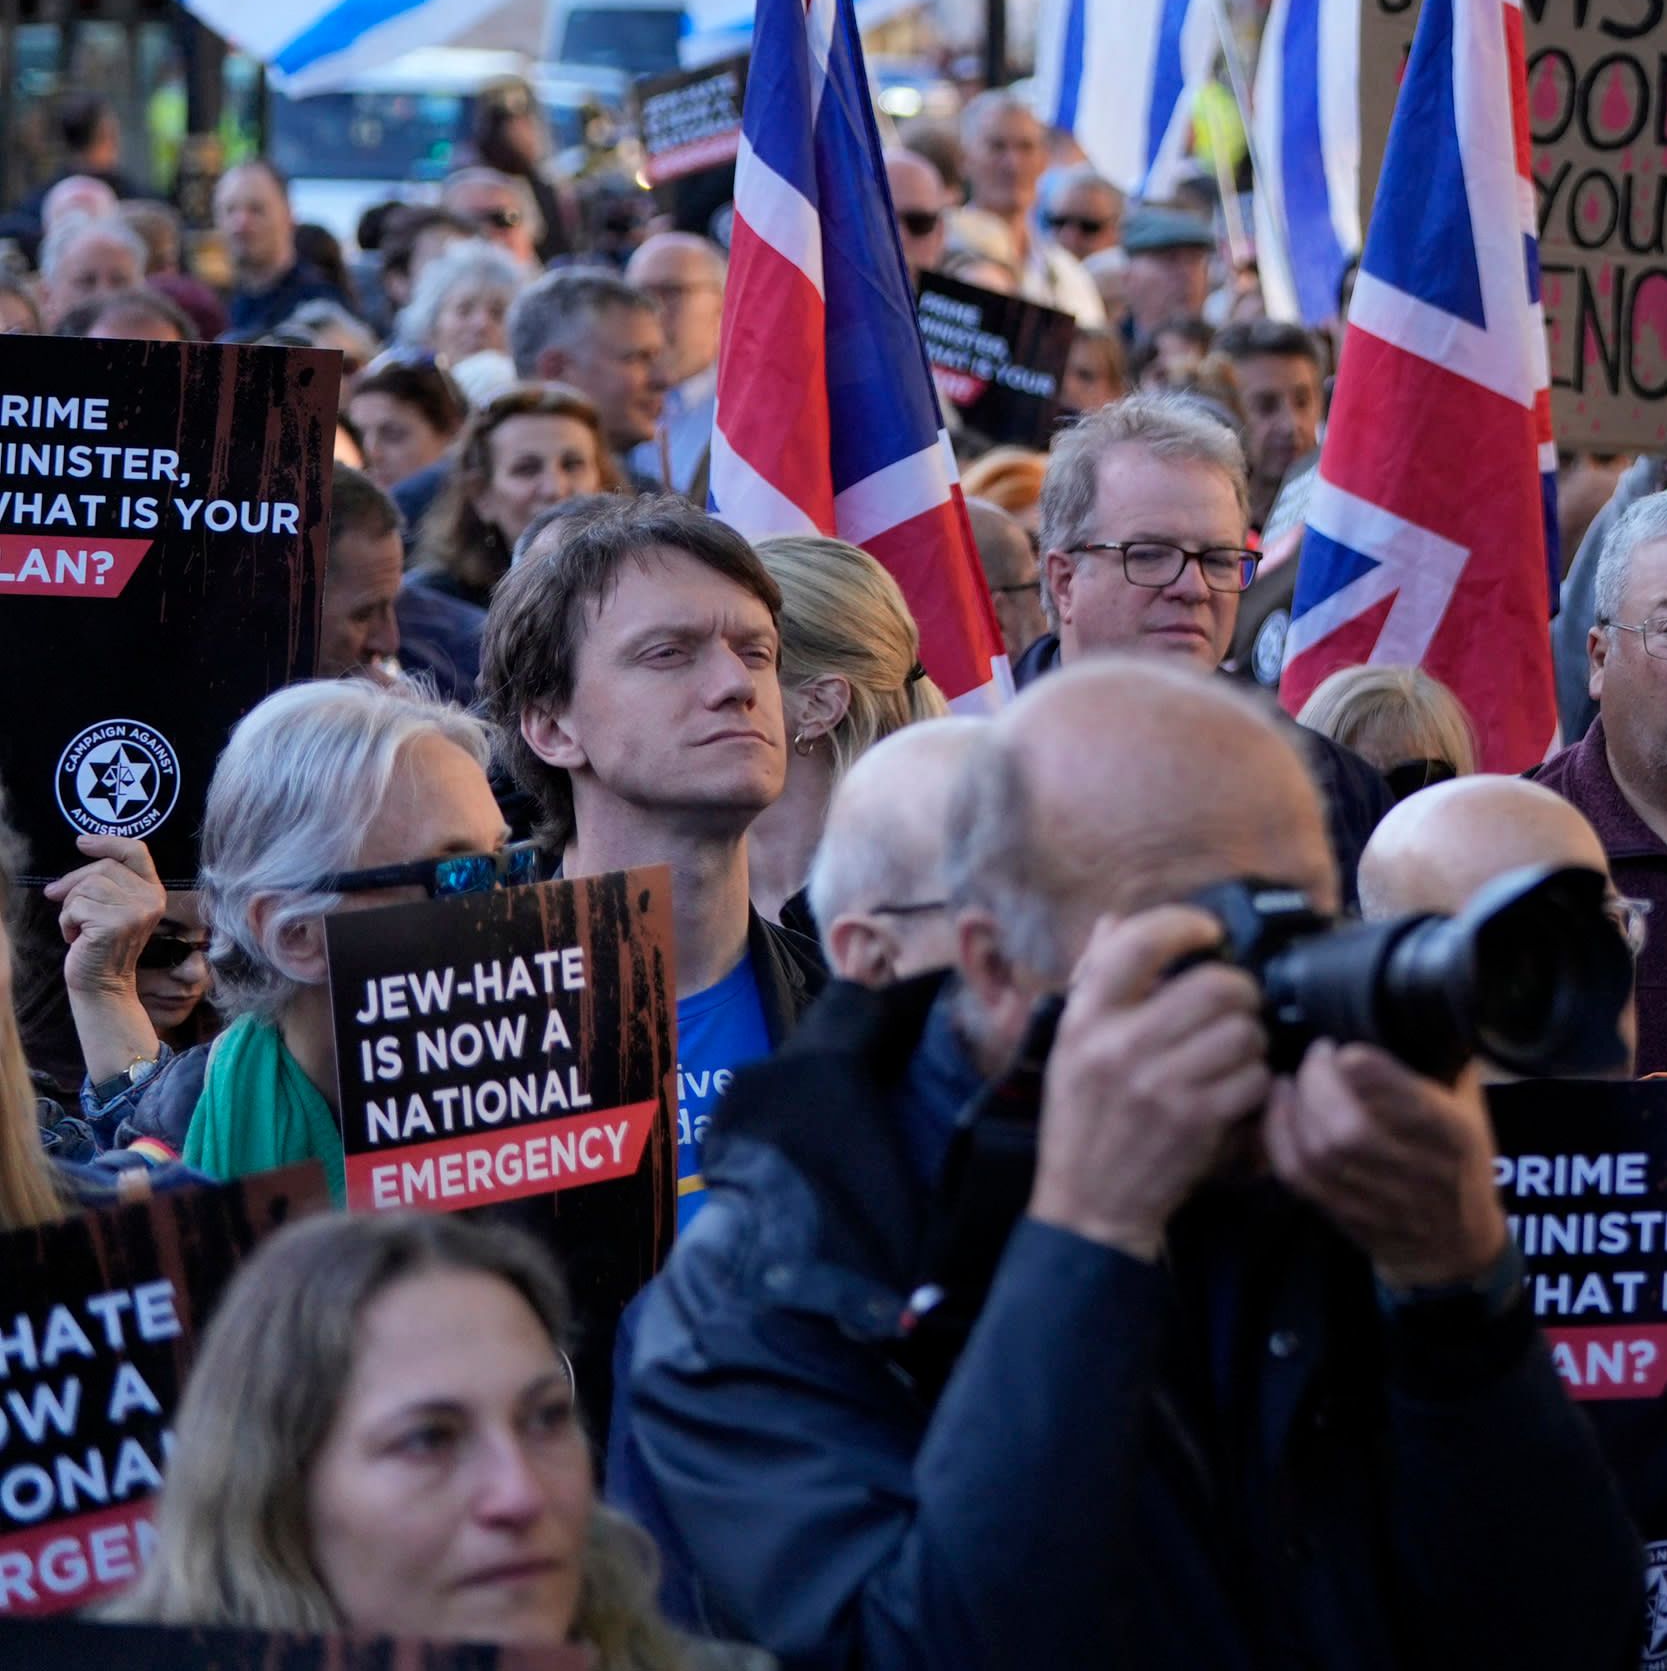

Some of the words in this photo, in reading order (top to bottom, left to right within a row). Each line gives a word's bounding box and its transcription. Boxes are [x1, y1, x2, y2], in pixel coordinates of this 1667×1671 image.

[0, 394, 110, 431] RIME
[0, 441, 191, 488] INISTER,
[120, 495, 159, 529] IS
[174, 498, 300, 534] YOUR
[0, 547, 115, 585] AN?
[65, 725, 126, 773] CAMPAIGN
[129, 728, 174, 775] AGAINST
[70, 808, 161, 837] ANTISEMITISM
[356, 946, 588, 1024] JEW-HATE
[361, 1036, 403, 1082] IS
[416, 1014, 527, 1073] NOW
[541, 1008, 571, 1053] A
[366, 1066, 592, 1144] NATIONAL
[677, 1063, 736, 1101] ive
[677, 1107, 713, 1145] da
[371, 1121, 629, 1209] EMERGENCY
[1526, 1270, 1648, 1315] HAT
[0, 1279, 184, 1378] HATE
[1552, 1338, 1658, 1385] AN?
[108, 1360, 164, 1424] A
